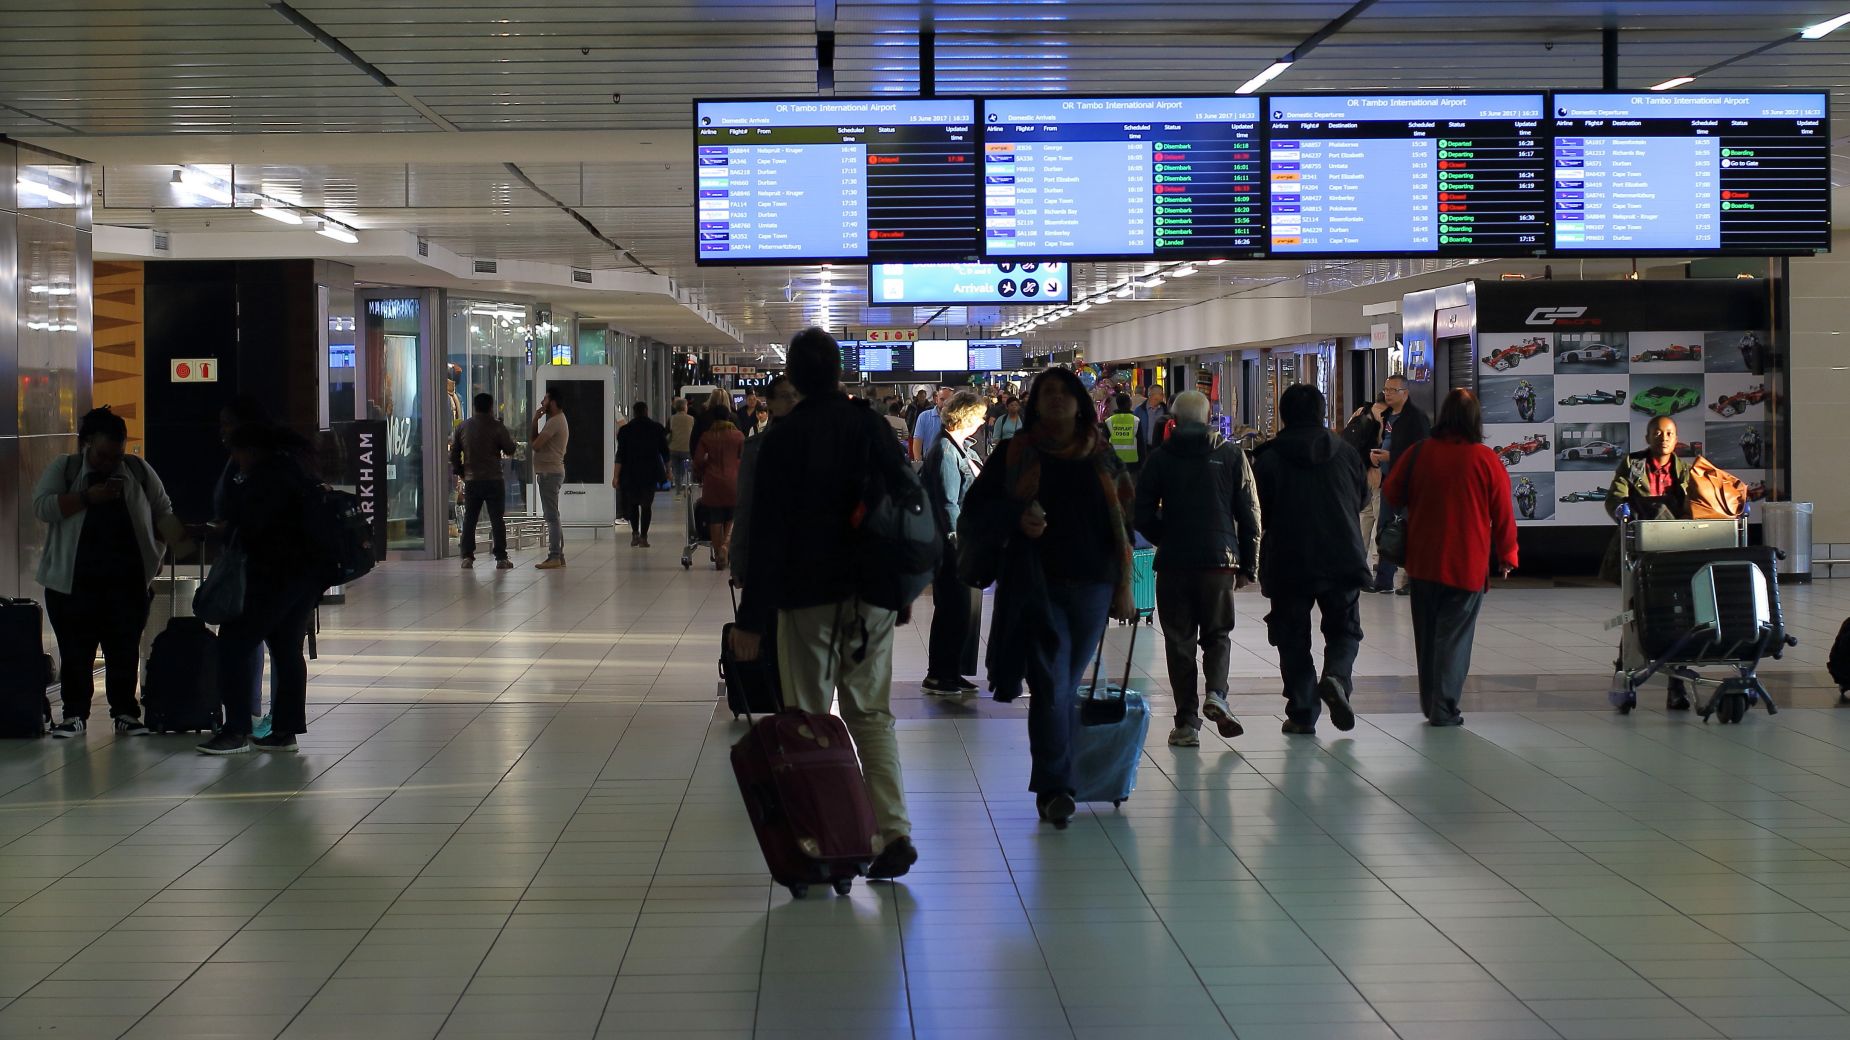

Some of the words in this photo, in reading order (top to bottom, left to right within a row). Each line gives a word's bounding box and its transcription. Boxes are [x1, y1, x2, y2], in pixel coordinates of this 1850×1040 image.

[1441, 99, 1466, 107] Airport
[953, 282, 994, 293] Arrivals
[360, 433, 374, 525] ARKHAM
